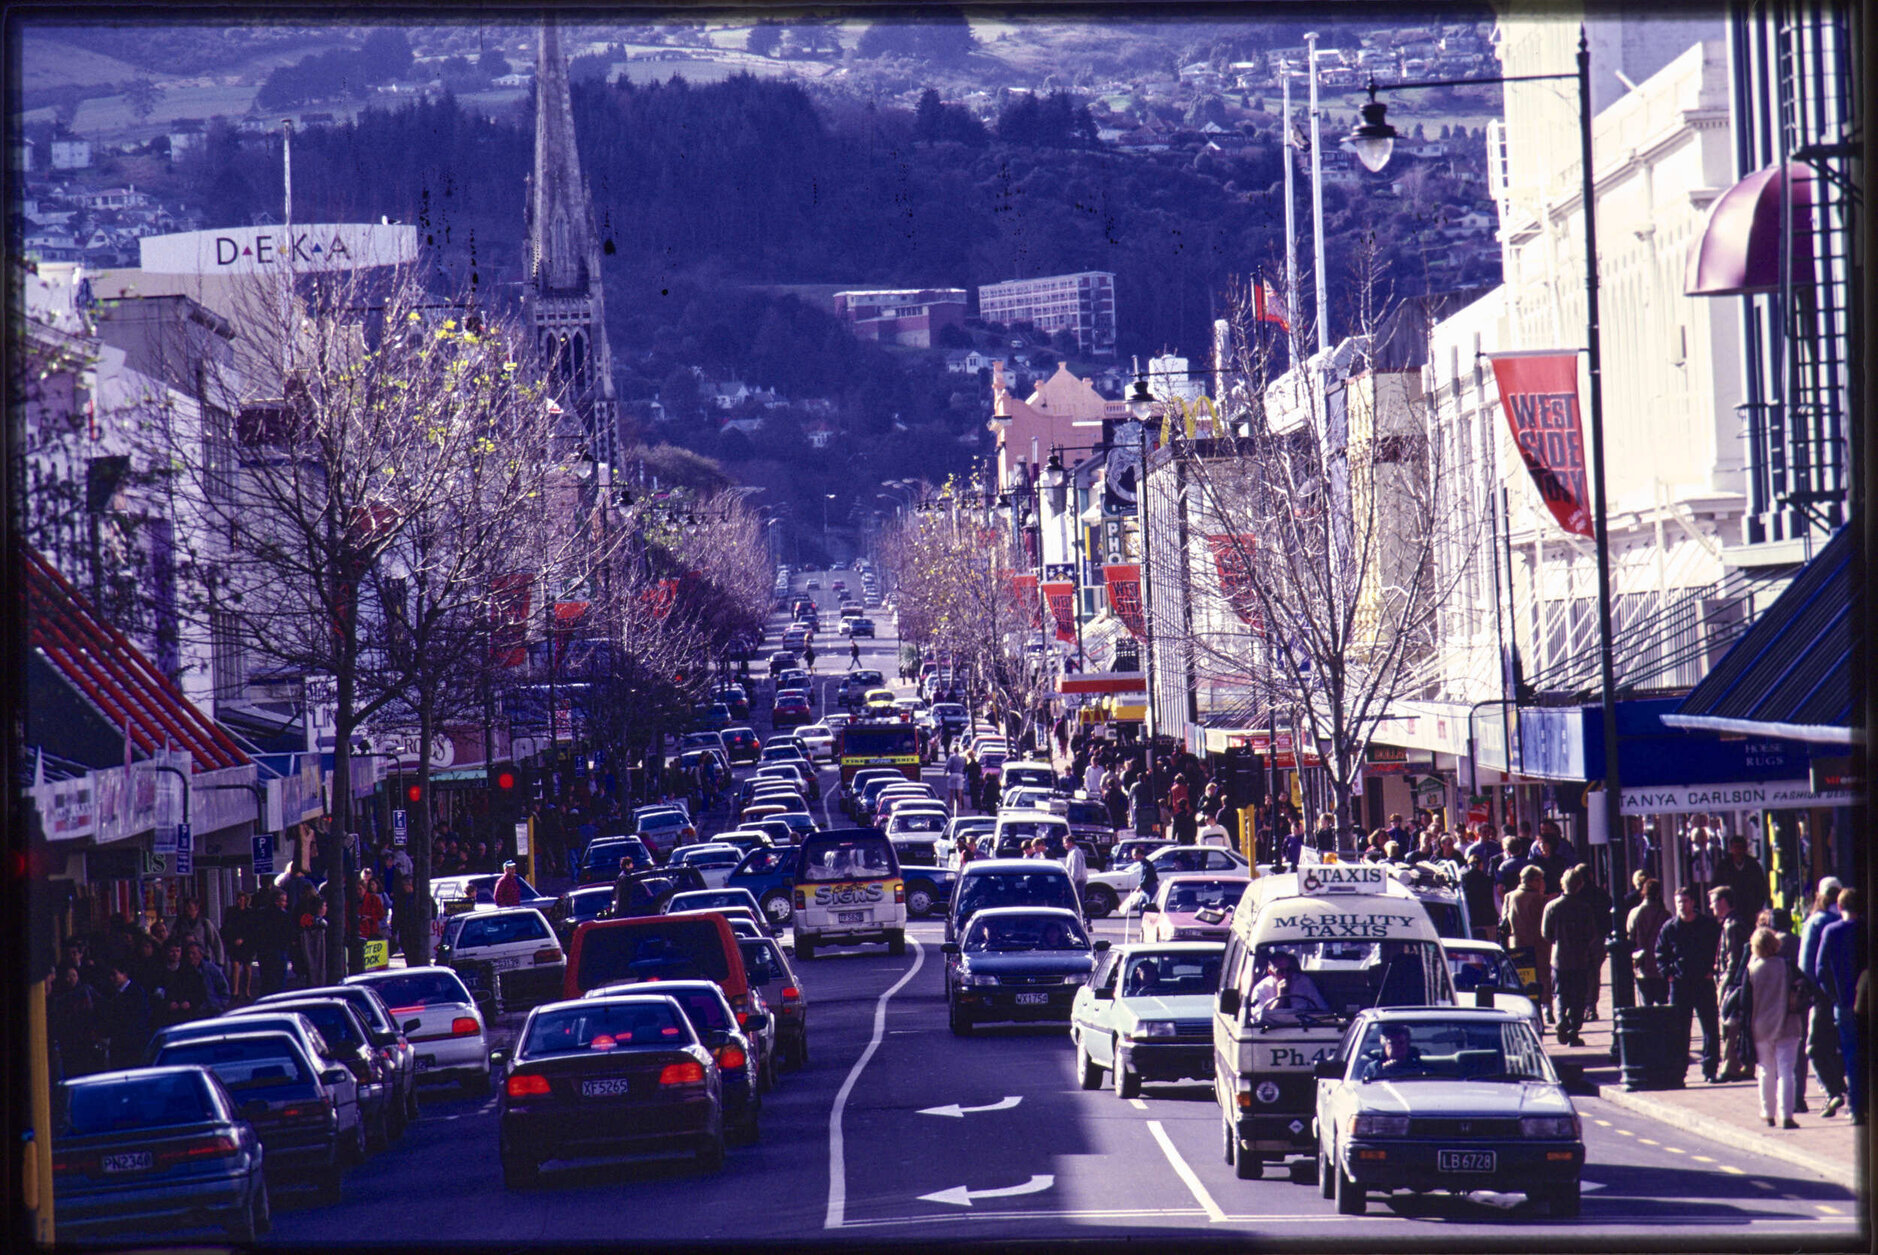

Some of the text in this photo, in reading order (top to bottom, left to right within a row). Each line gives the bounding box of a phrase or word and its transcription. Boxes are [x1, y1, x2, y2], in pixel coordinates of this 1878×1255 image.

[1508, 392, 1576, 430] WEST
[1519, 430, 1582, 468] SIDE
[1619, 792, 1677, 808] TANYA
[1687, 789, 1766, 805] CARLSON
[1318, 868, 1382, 883] TAXIS
[1301, 925, 1388, 938] TAXIS
[583, 1079, 627, 1095] XF5265
